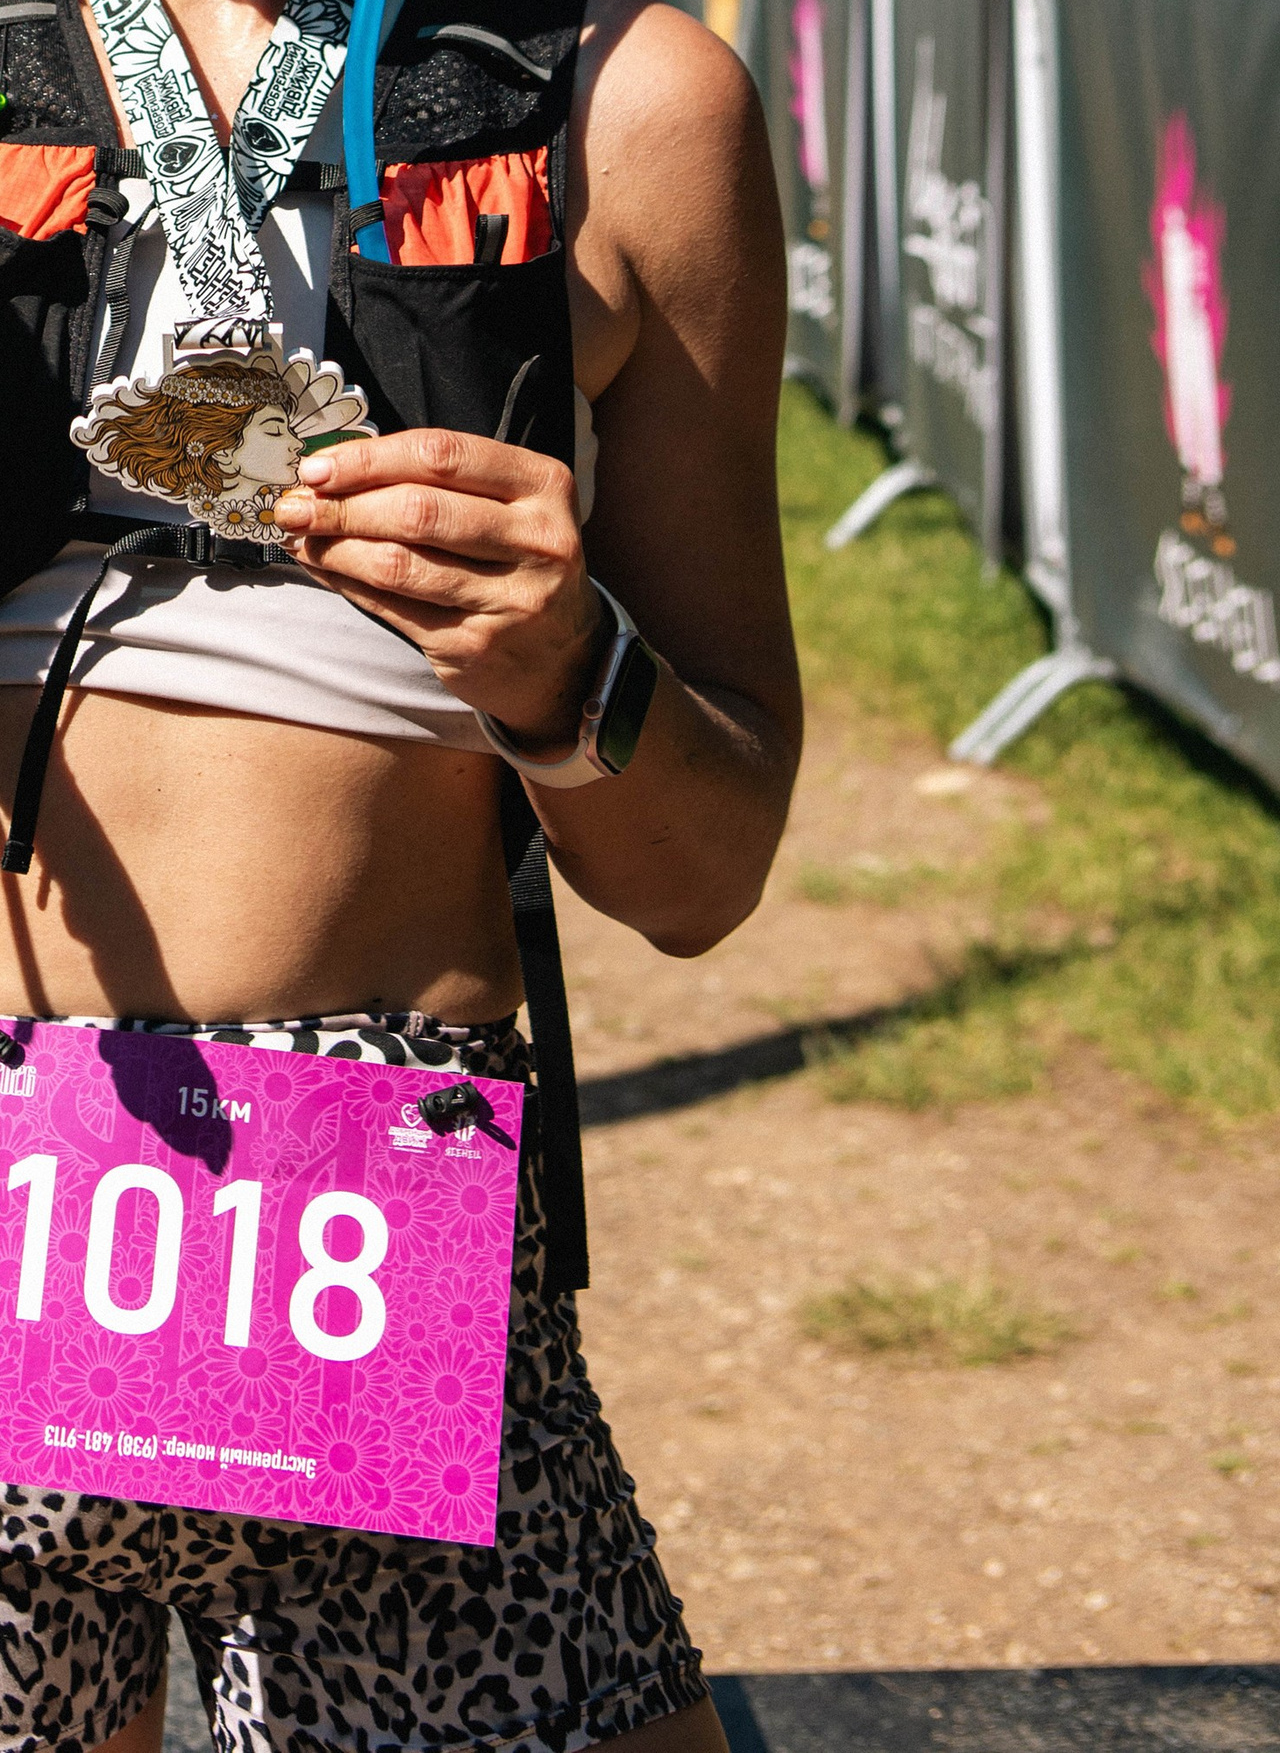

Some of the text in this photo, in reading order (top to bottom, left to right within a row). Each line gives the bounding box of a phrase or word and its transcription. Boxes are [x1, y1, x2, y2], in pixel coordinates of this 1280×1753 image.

[158, 73, 186, 123] ДВИЖ
[262, 45, 301, 117] ДОБРЕЙШИЙ
[280, 60, 316, 115] ДВИЖ
[7, 1153, 389, 1363] 1018
[44, 1425, 317, 1479] Экстренный номер: (938) 481-9113
